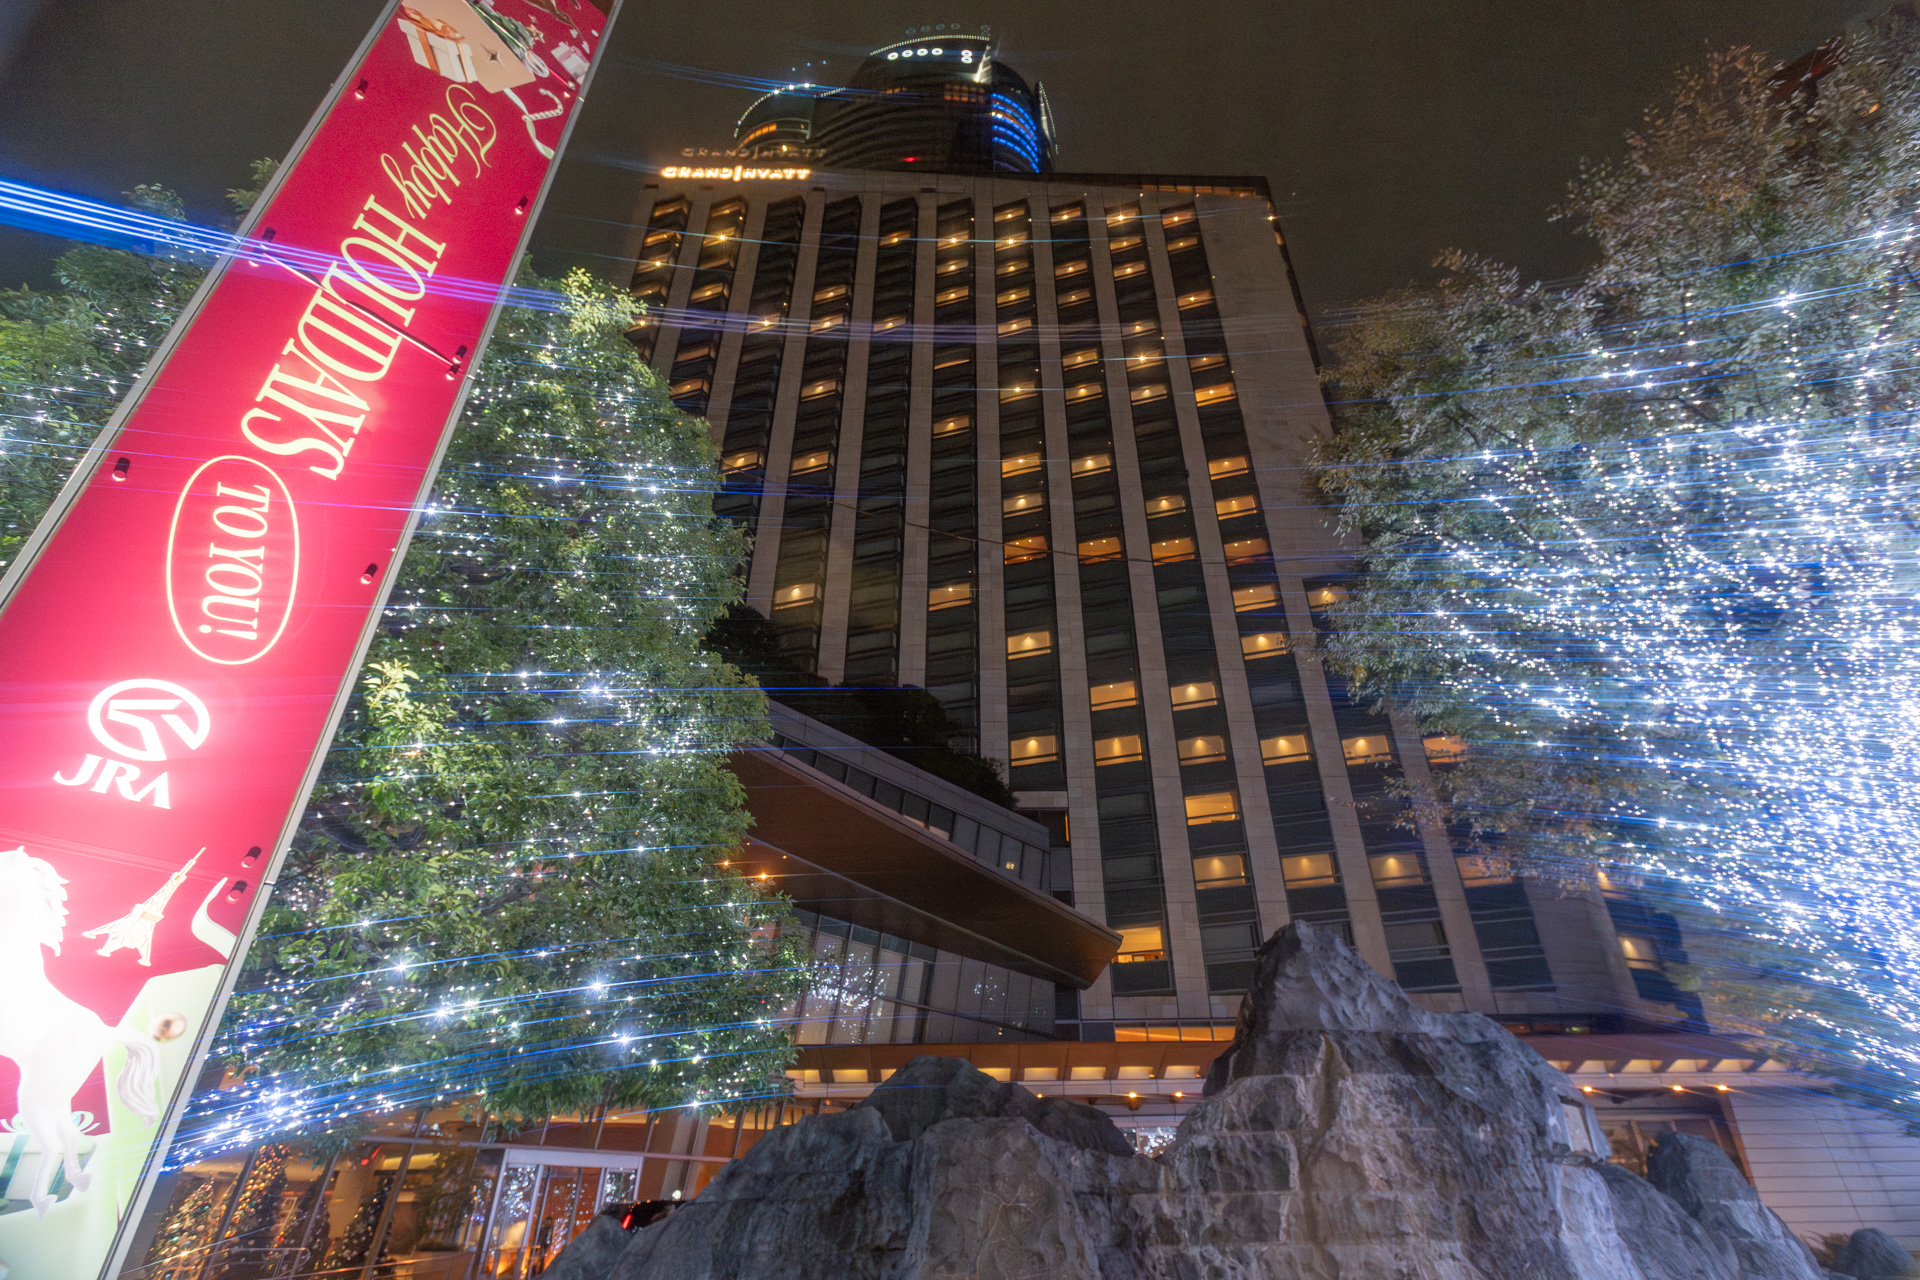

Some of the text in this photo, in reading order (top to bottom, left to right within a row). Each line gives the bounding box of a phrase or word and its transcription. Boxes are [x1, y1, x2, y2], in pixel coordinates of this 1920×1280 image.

[381, 83, 497, 220] Happy
[661, 165, 811, 181] GRAND HYATT
[241, 194, 447, 481] HOLIDAYS
[199, 480, 271, 642] TO YOU!
[52, 752, 172, 810] JRA
